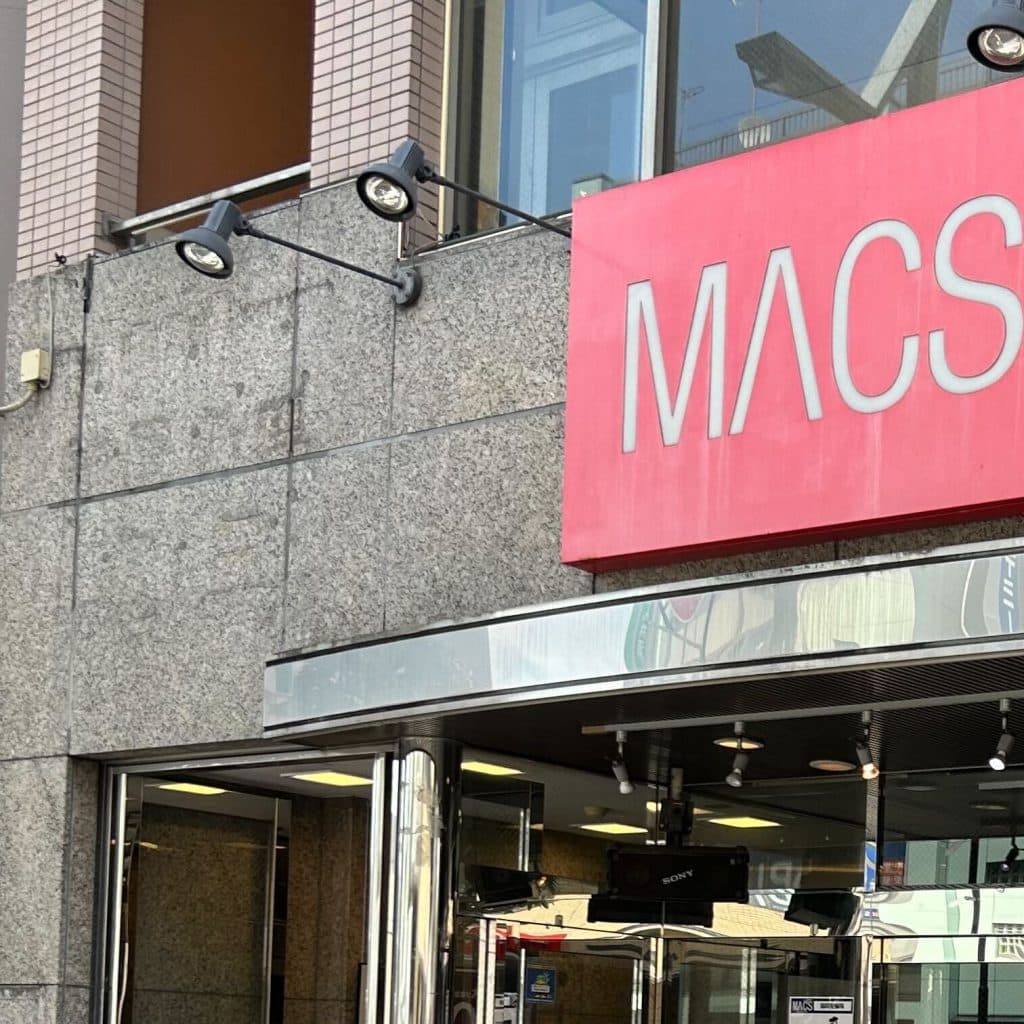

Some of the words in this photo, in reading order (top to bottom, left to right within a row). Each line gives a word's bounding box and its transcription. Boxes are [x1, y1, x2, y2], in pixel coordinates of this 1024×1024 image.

[622, 194, 1024, 454] MACS
[662, 869, 693, 885] SONY
[792, 1000, 813, 1013] MACS
